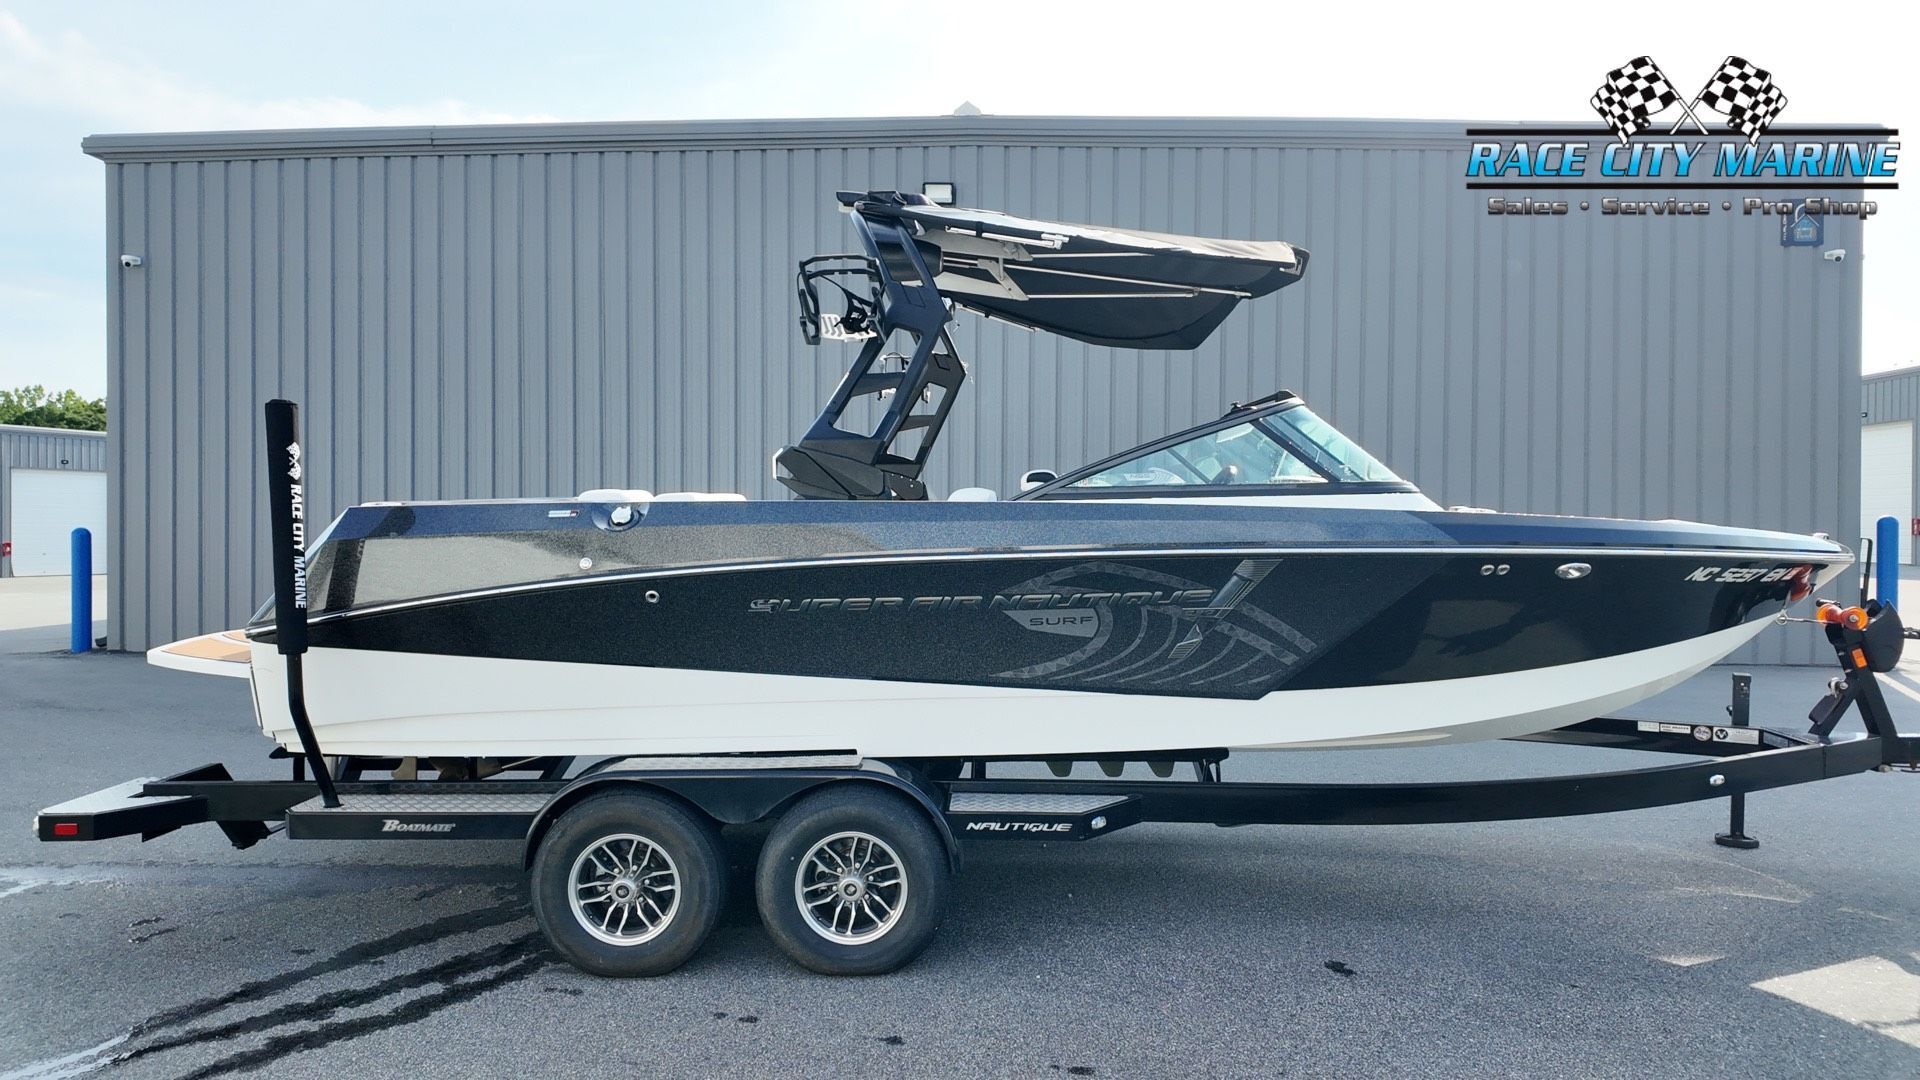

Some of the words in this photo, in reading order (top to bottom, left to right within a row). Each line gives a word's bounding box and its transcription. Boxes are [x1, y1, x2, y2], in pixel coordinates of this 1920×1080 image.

[290, 484, 303, 519] RACE
[292, 523, 305, 552] CITY
[293, 556, 307, 609] MARINE
[1684, 566, 1721, 582] NC
[748, 597, 904, 614] SUPER
[908, 596, 983, 612] AIR
[989, 589, 1215, 609] NAUTIQUE
[1029, 615, 1094, 627] SURF
[966, 822, 1073, 832] NAUTIQUE
